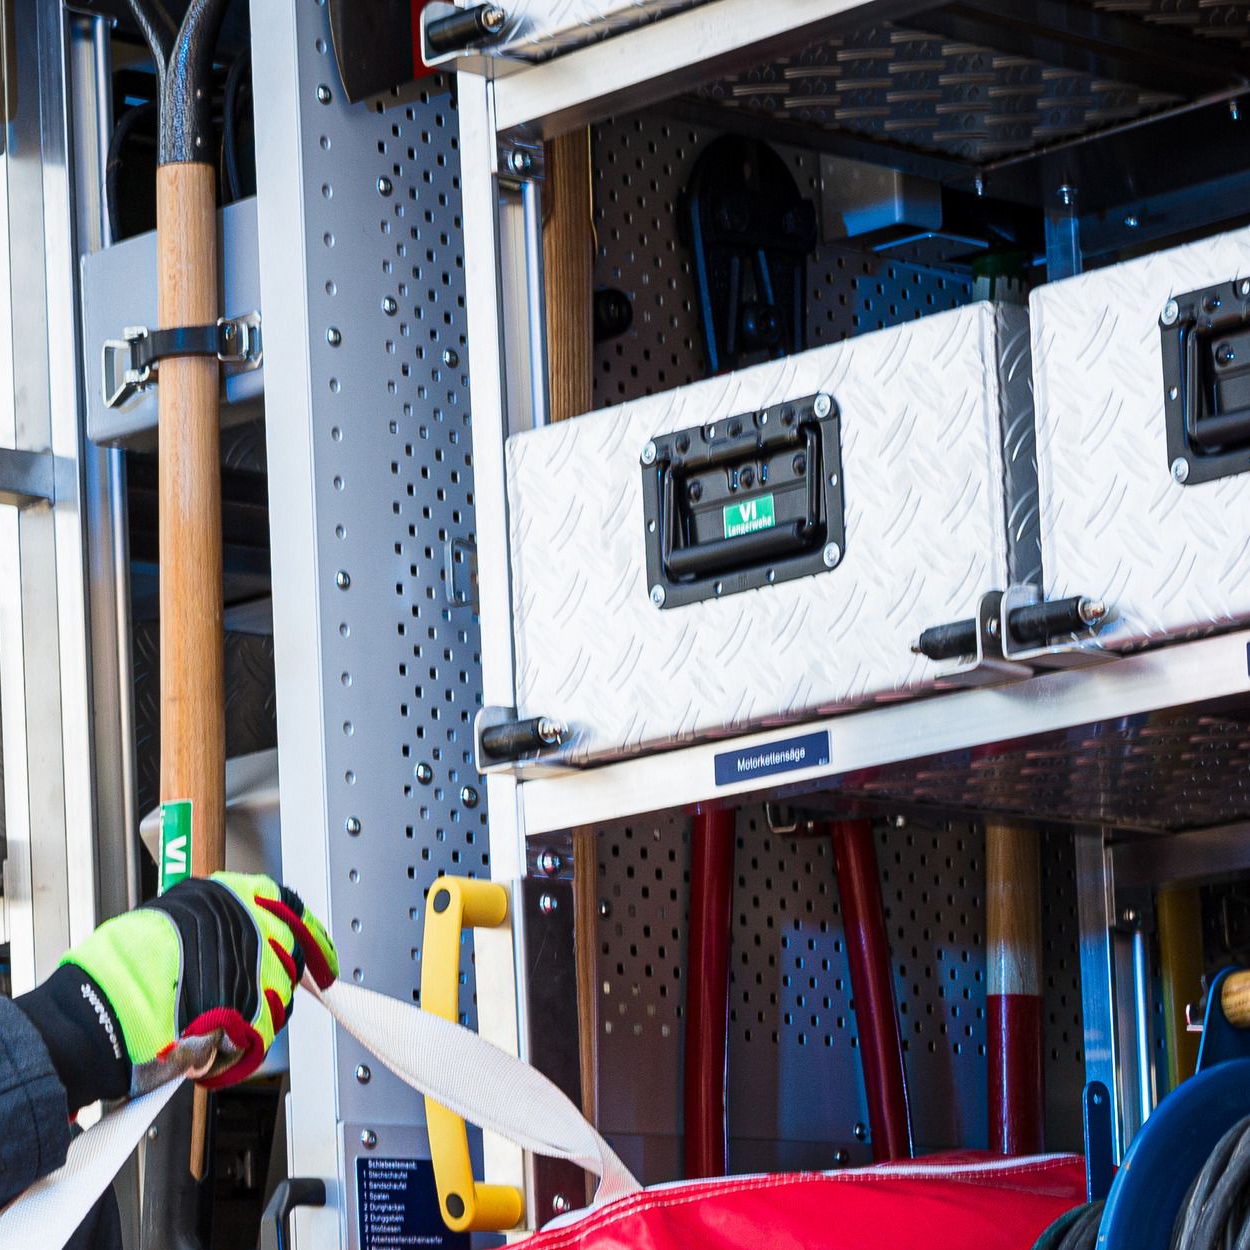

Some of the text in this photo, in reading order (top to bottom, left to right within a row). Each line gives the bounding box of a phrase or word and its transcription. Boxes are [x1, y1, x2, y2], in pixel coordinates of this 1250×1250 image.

[739, 501, 757, 523] VI
[737, 747, 806, 772] Motorkettensäge
[165, 835, 187, 875] VI
